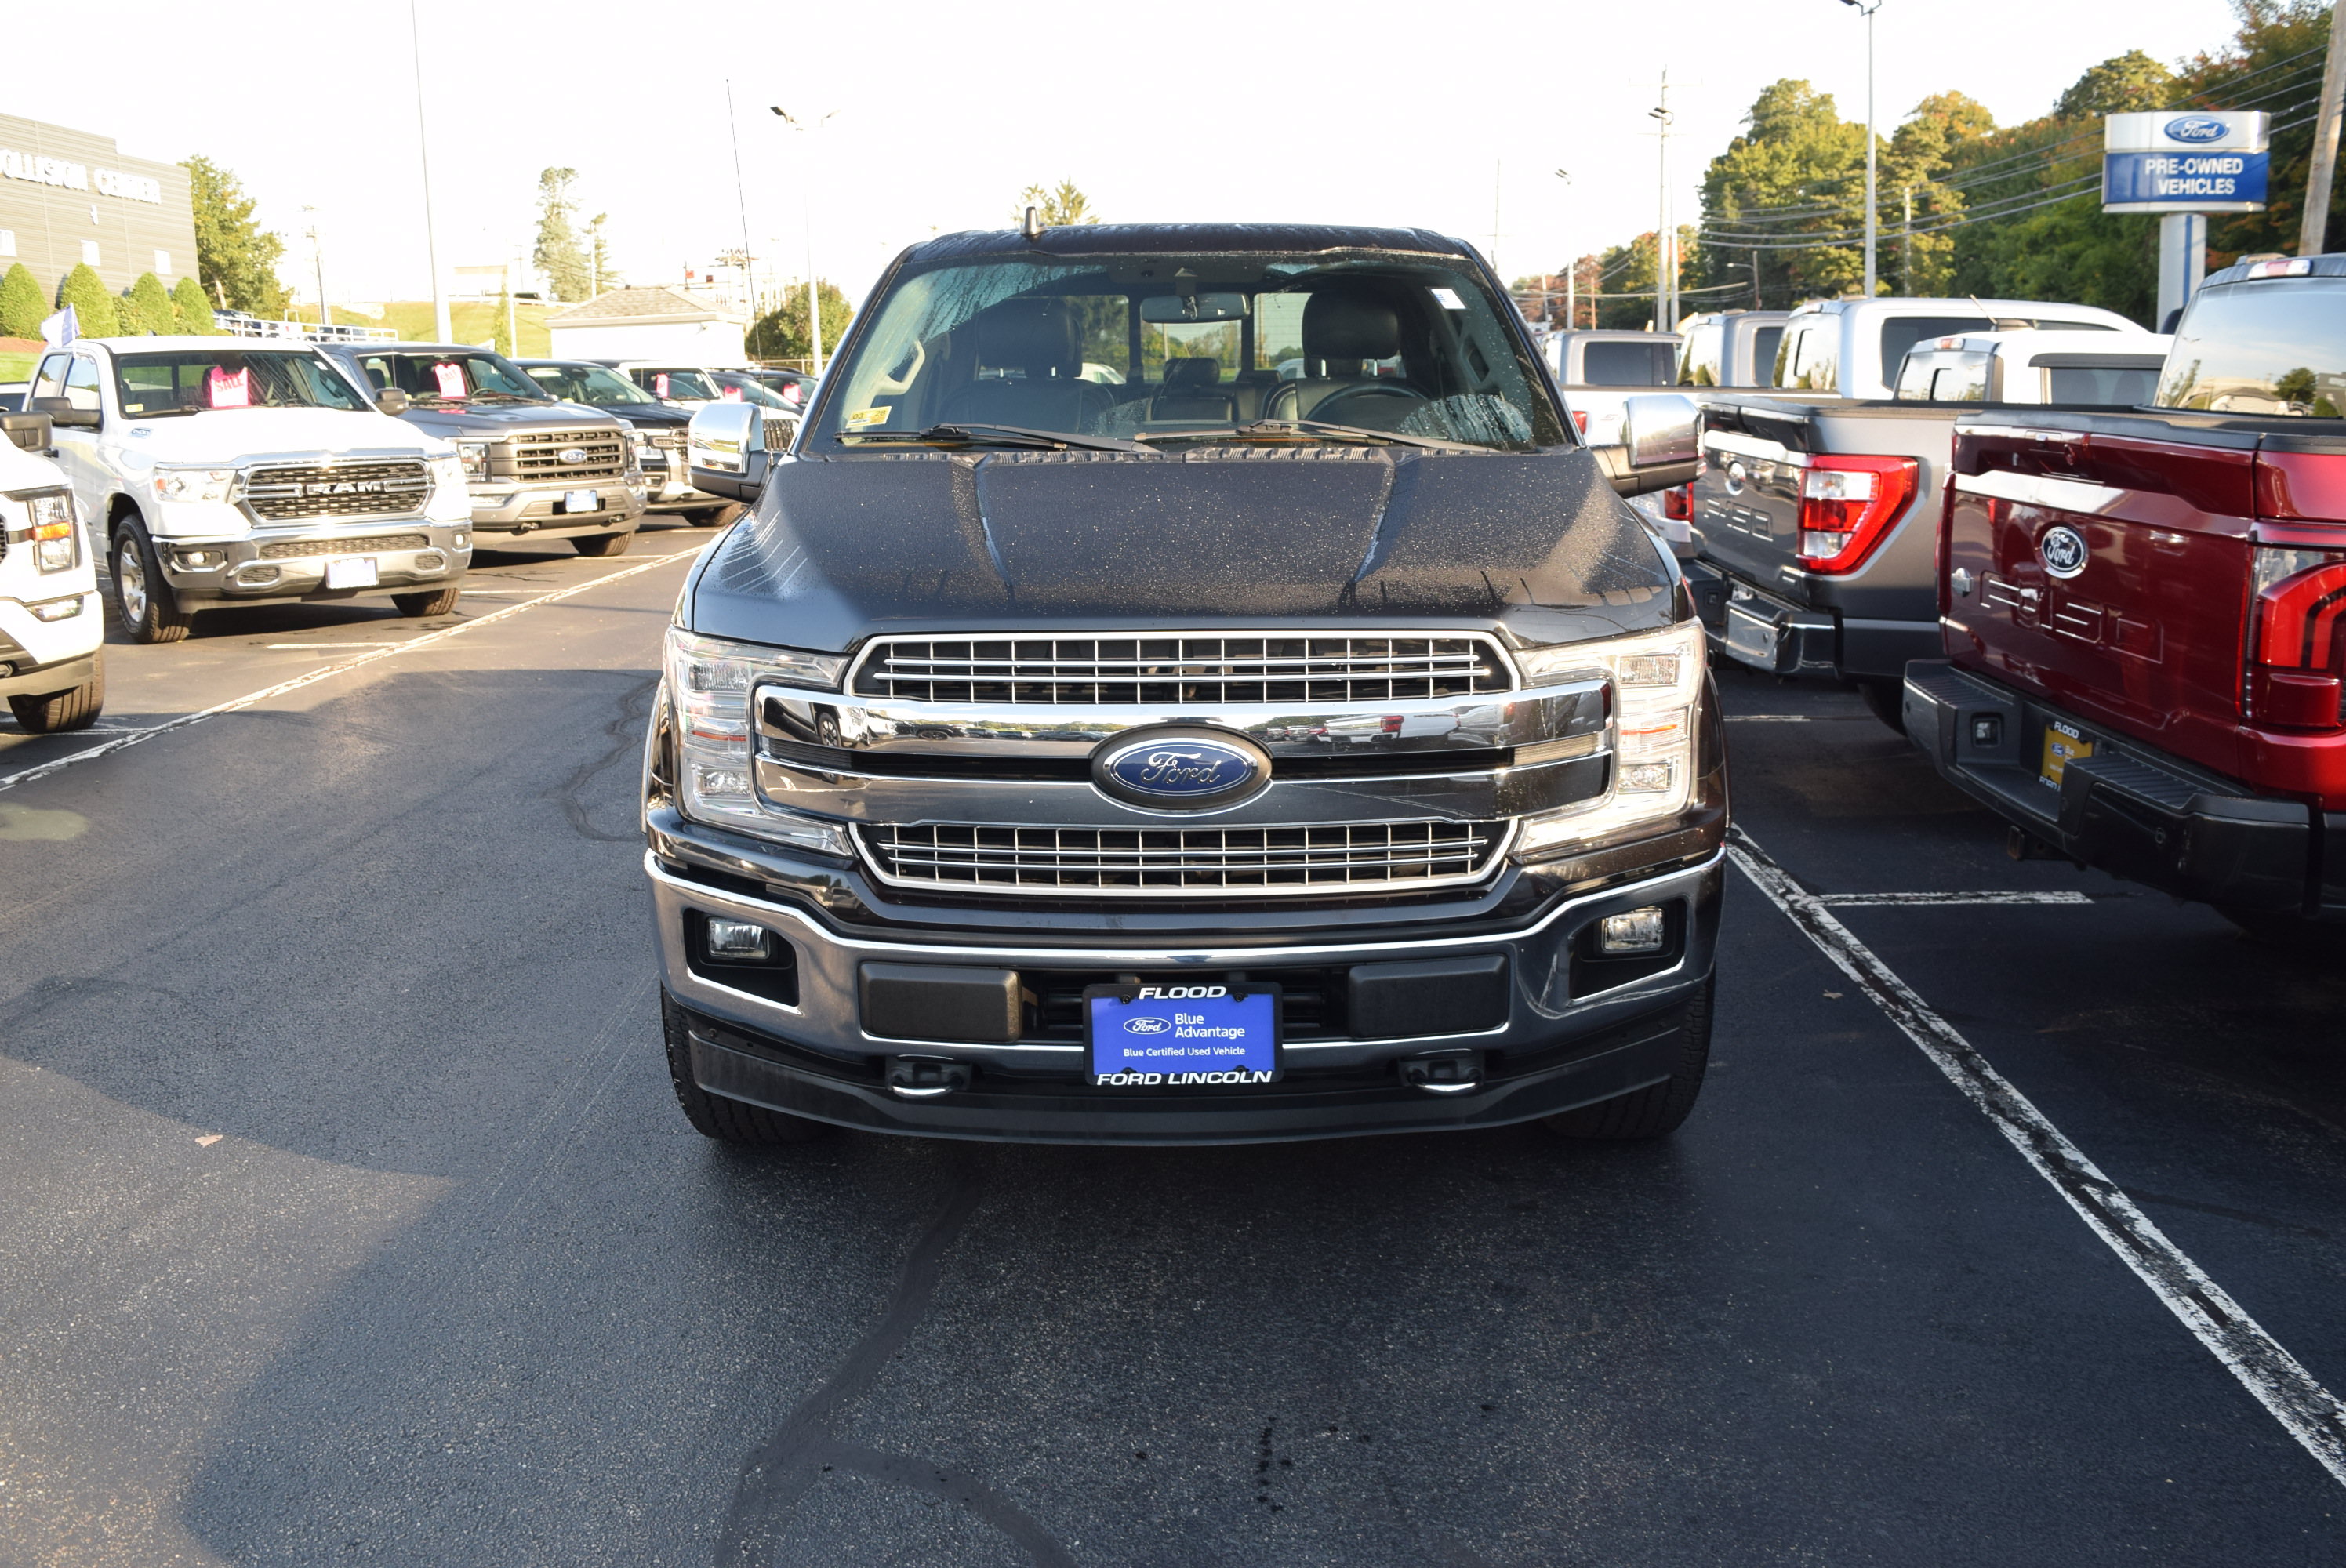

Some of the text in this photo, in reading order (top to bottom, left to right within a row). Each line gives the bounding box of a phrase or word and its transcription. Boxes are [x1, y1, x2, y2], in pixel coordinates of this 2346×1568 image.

[2180, 120, 2218, 138] Ford
[2144, 158, 2244, 175] PRE-OWNED
[2158, 177, 2235, 194] VEHICLES
[214, 376, 244, 392] SALE
[307, 481, 381, 495] RAM
[2047, 532, 2075, 566] Ford
[2054, 721, 2079, 739] FLOOD
[1141, 751, 1221, 784] Ford
[1138, 986, 1226, 1000] FLOOD
[1131, 1018, 1162, 1033] Ford
[1175, 1013, 1204, 1025] Blue
[1175, 1026, 1245, 1040] Advantage
[1123, 1047, 1246, 1057] Blue Certified Used Vehicle
[1097, 1070, 1273, 1086] FORD LINCOLN
